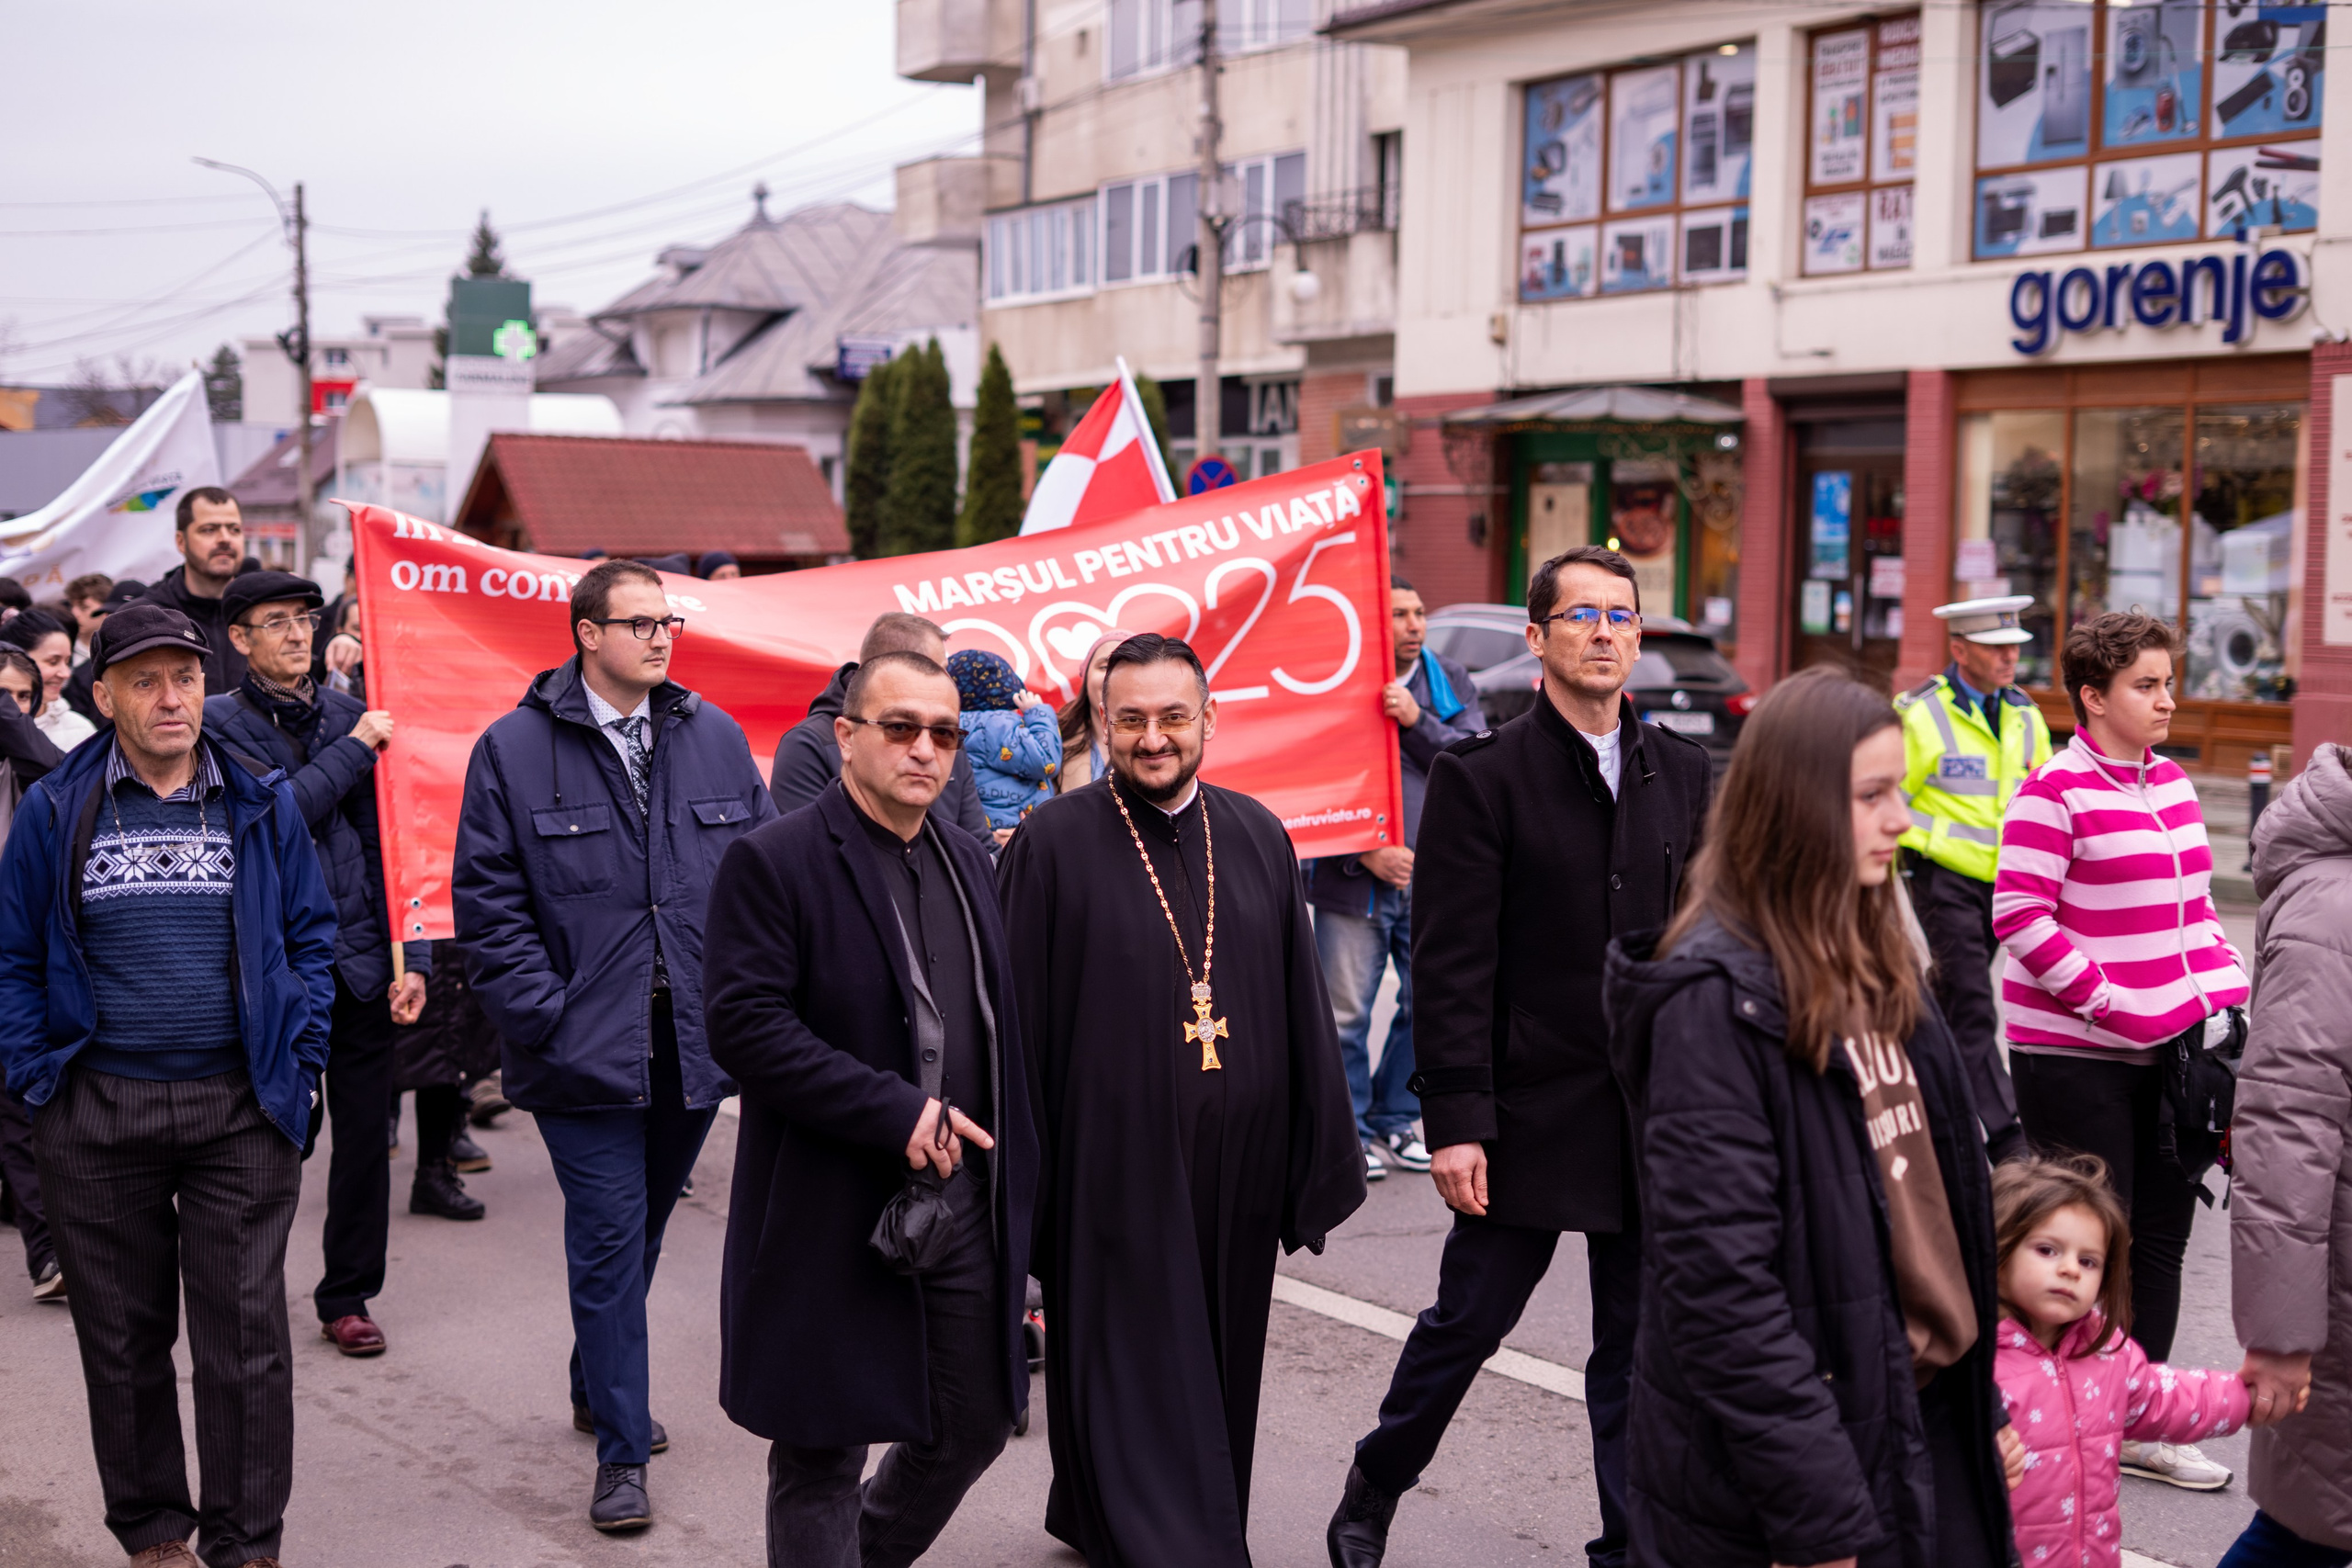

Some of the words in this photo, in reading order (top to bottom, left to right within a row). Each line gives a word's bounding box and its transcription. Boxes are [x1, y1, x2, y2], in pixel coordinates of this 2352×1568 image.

[2010, 226, 2301, 356] gorenje
[390, 559, 469, 593] om
[892, 558, 1079, 615] MARȘUL
[1073, 515, 1240, 584] PENTRU
[1238, 479, 1362, 541] VIAȚĂ
